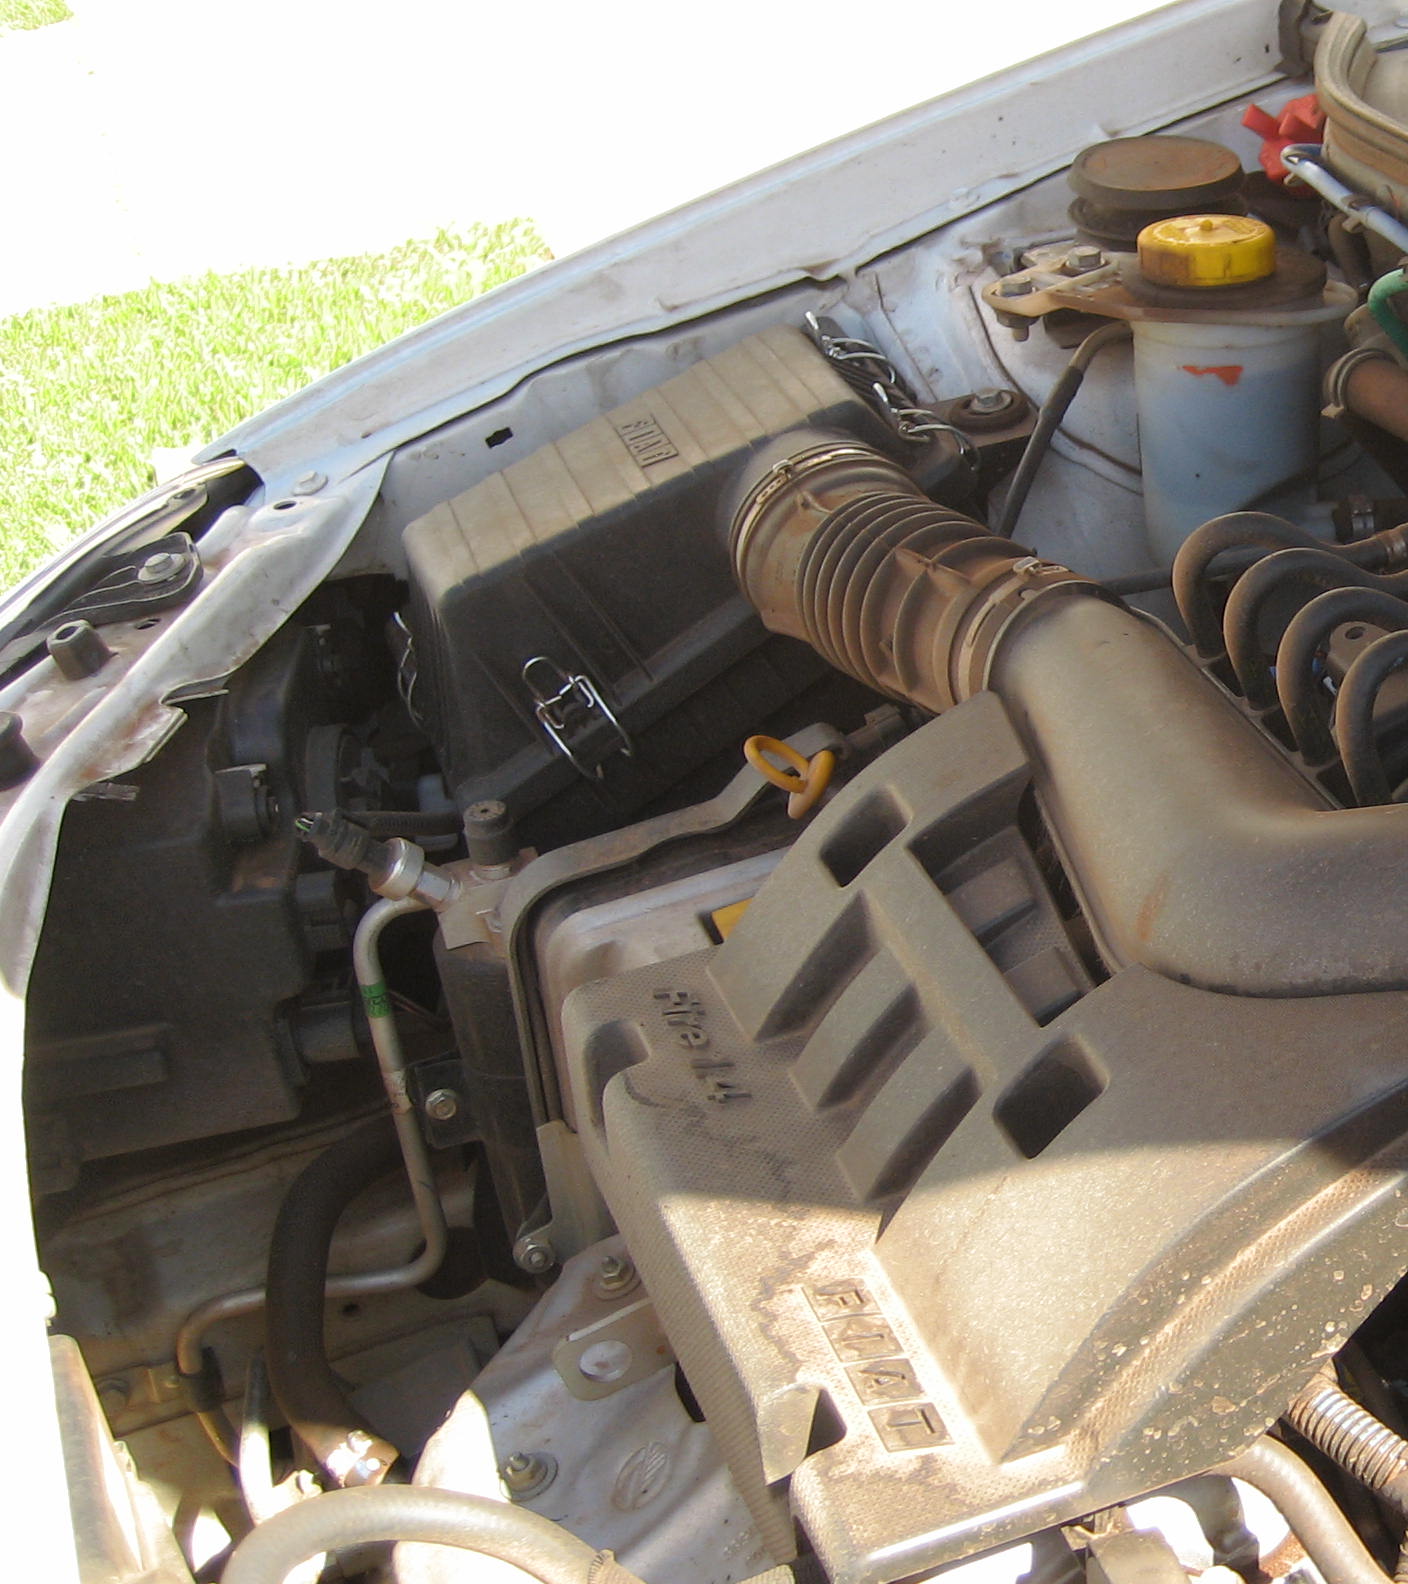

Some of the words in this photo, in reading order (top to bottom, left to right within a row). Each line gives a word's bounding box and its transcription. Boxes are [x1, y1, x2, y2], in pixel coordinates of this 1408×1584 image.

[619, 416, 675, 466] FIAT
[653, 989, 710, 1050] Fire
[811, 1280, 945, 1442] FIAT
